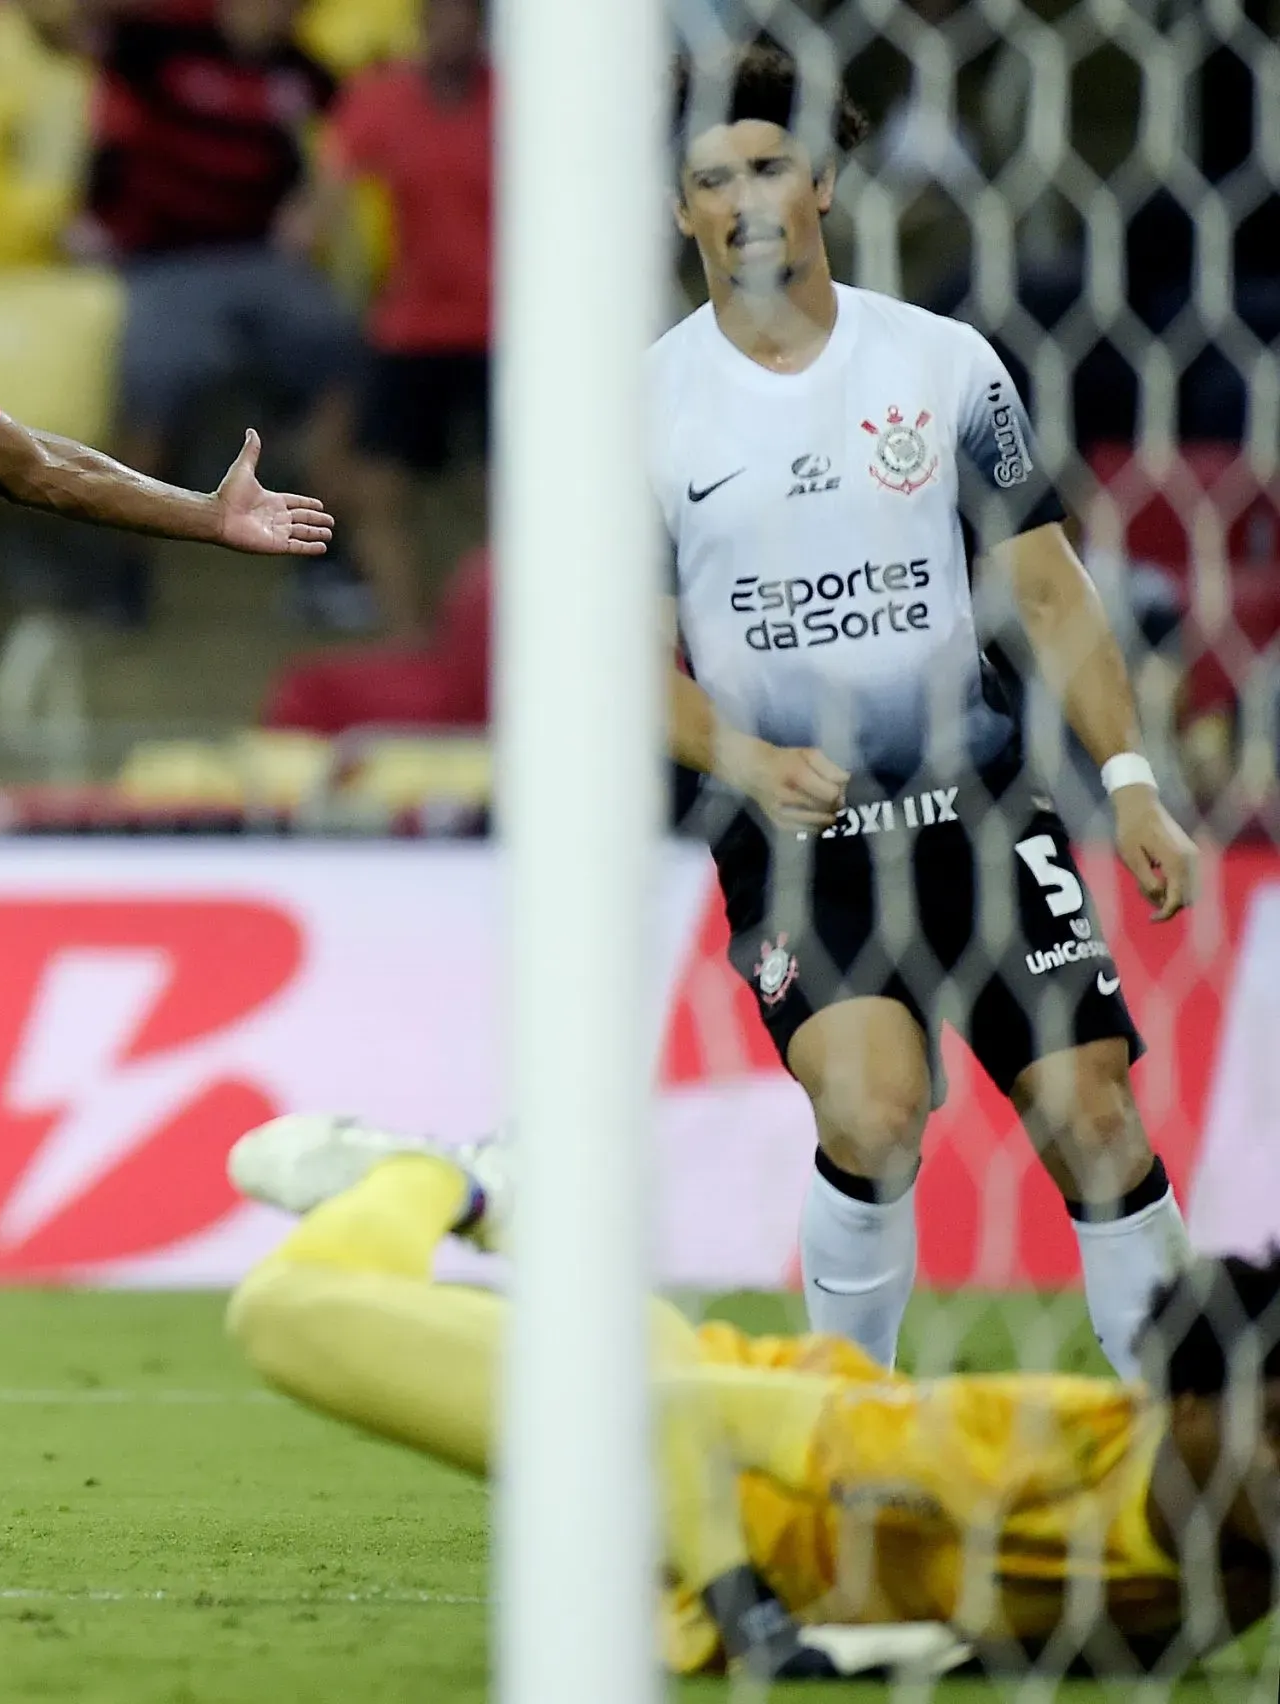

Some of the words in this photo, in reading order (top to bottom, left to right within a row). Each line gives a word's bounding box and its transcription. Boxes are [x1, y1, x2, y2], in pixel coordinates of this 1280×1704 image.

[786, 477, 842, 498] ALE
[731, 558, 931, 617] Esportes
[1015, 834, 1084, 918] 5
